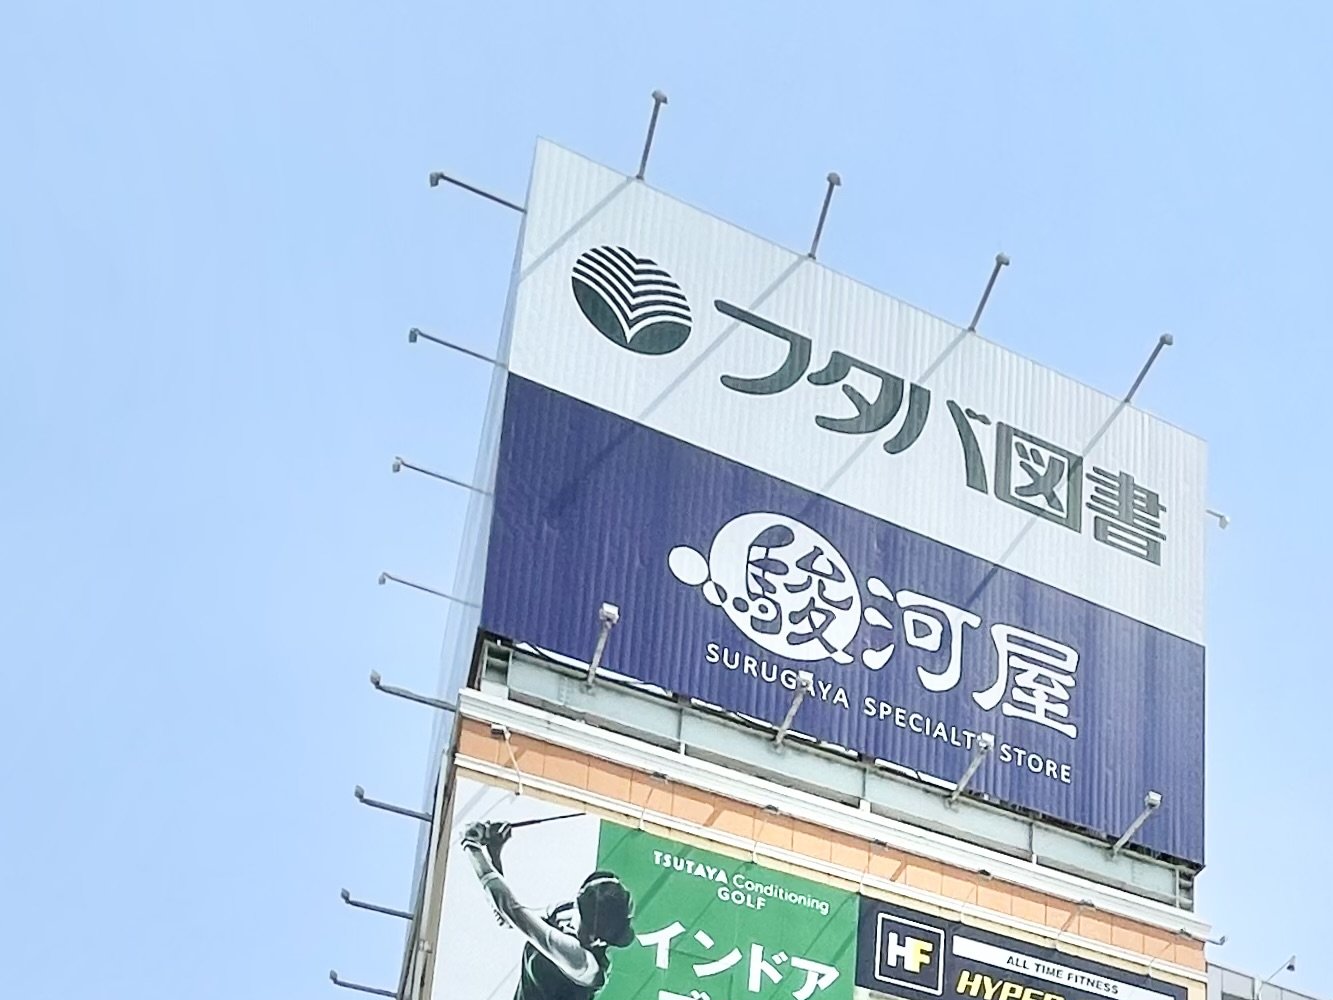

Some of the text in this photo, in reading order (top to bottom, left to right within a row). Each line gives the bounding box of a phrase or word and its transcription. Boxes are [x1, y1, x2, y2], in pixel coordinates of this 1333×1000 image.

[713, 298, 1167, 566] フタバ図書
[708, 511, 1080, 740] 駿河屋
[863, 696, 984, 753] SPECIALT
[1000, 742, 1073, 785] STORE
[653, 850, 830, 916] TSUTAYA Conditioning
[717, 886, 766, 910] GOLF
[1006, 954, 1120, 996] ALL TIME FITNESS
